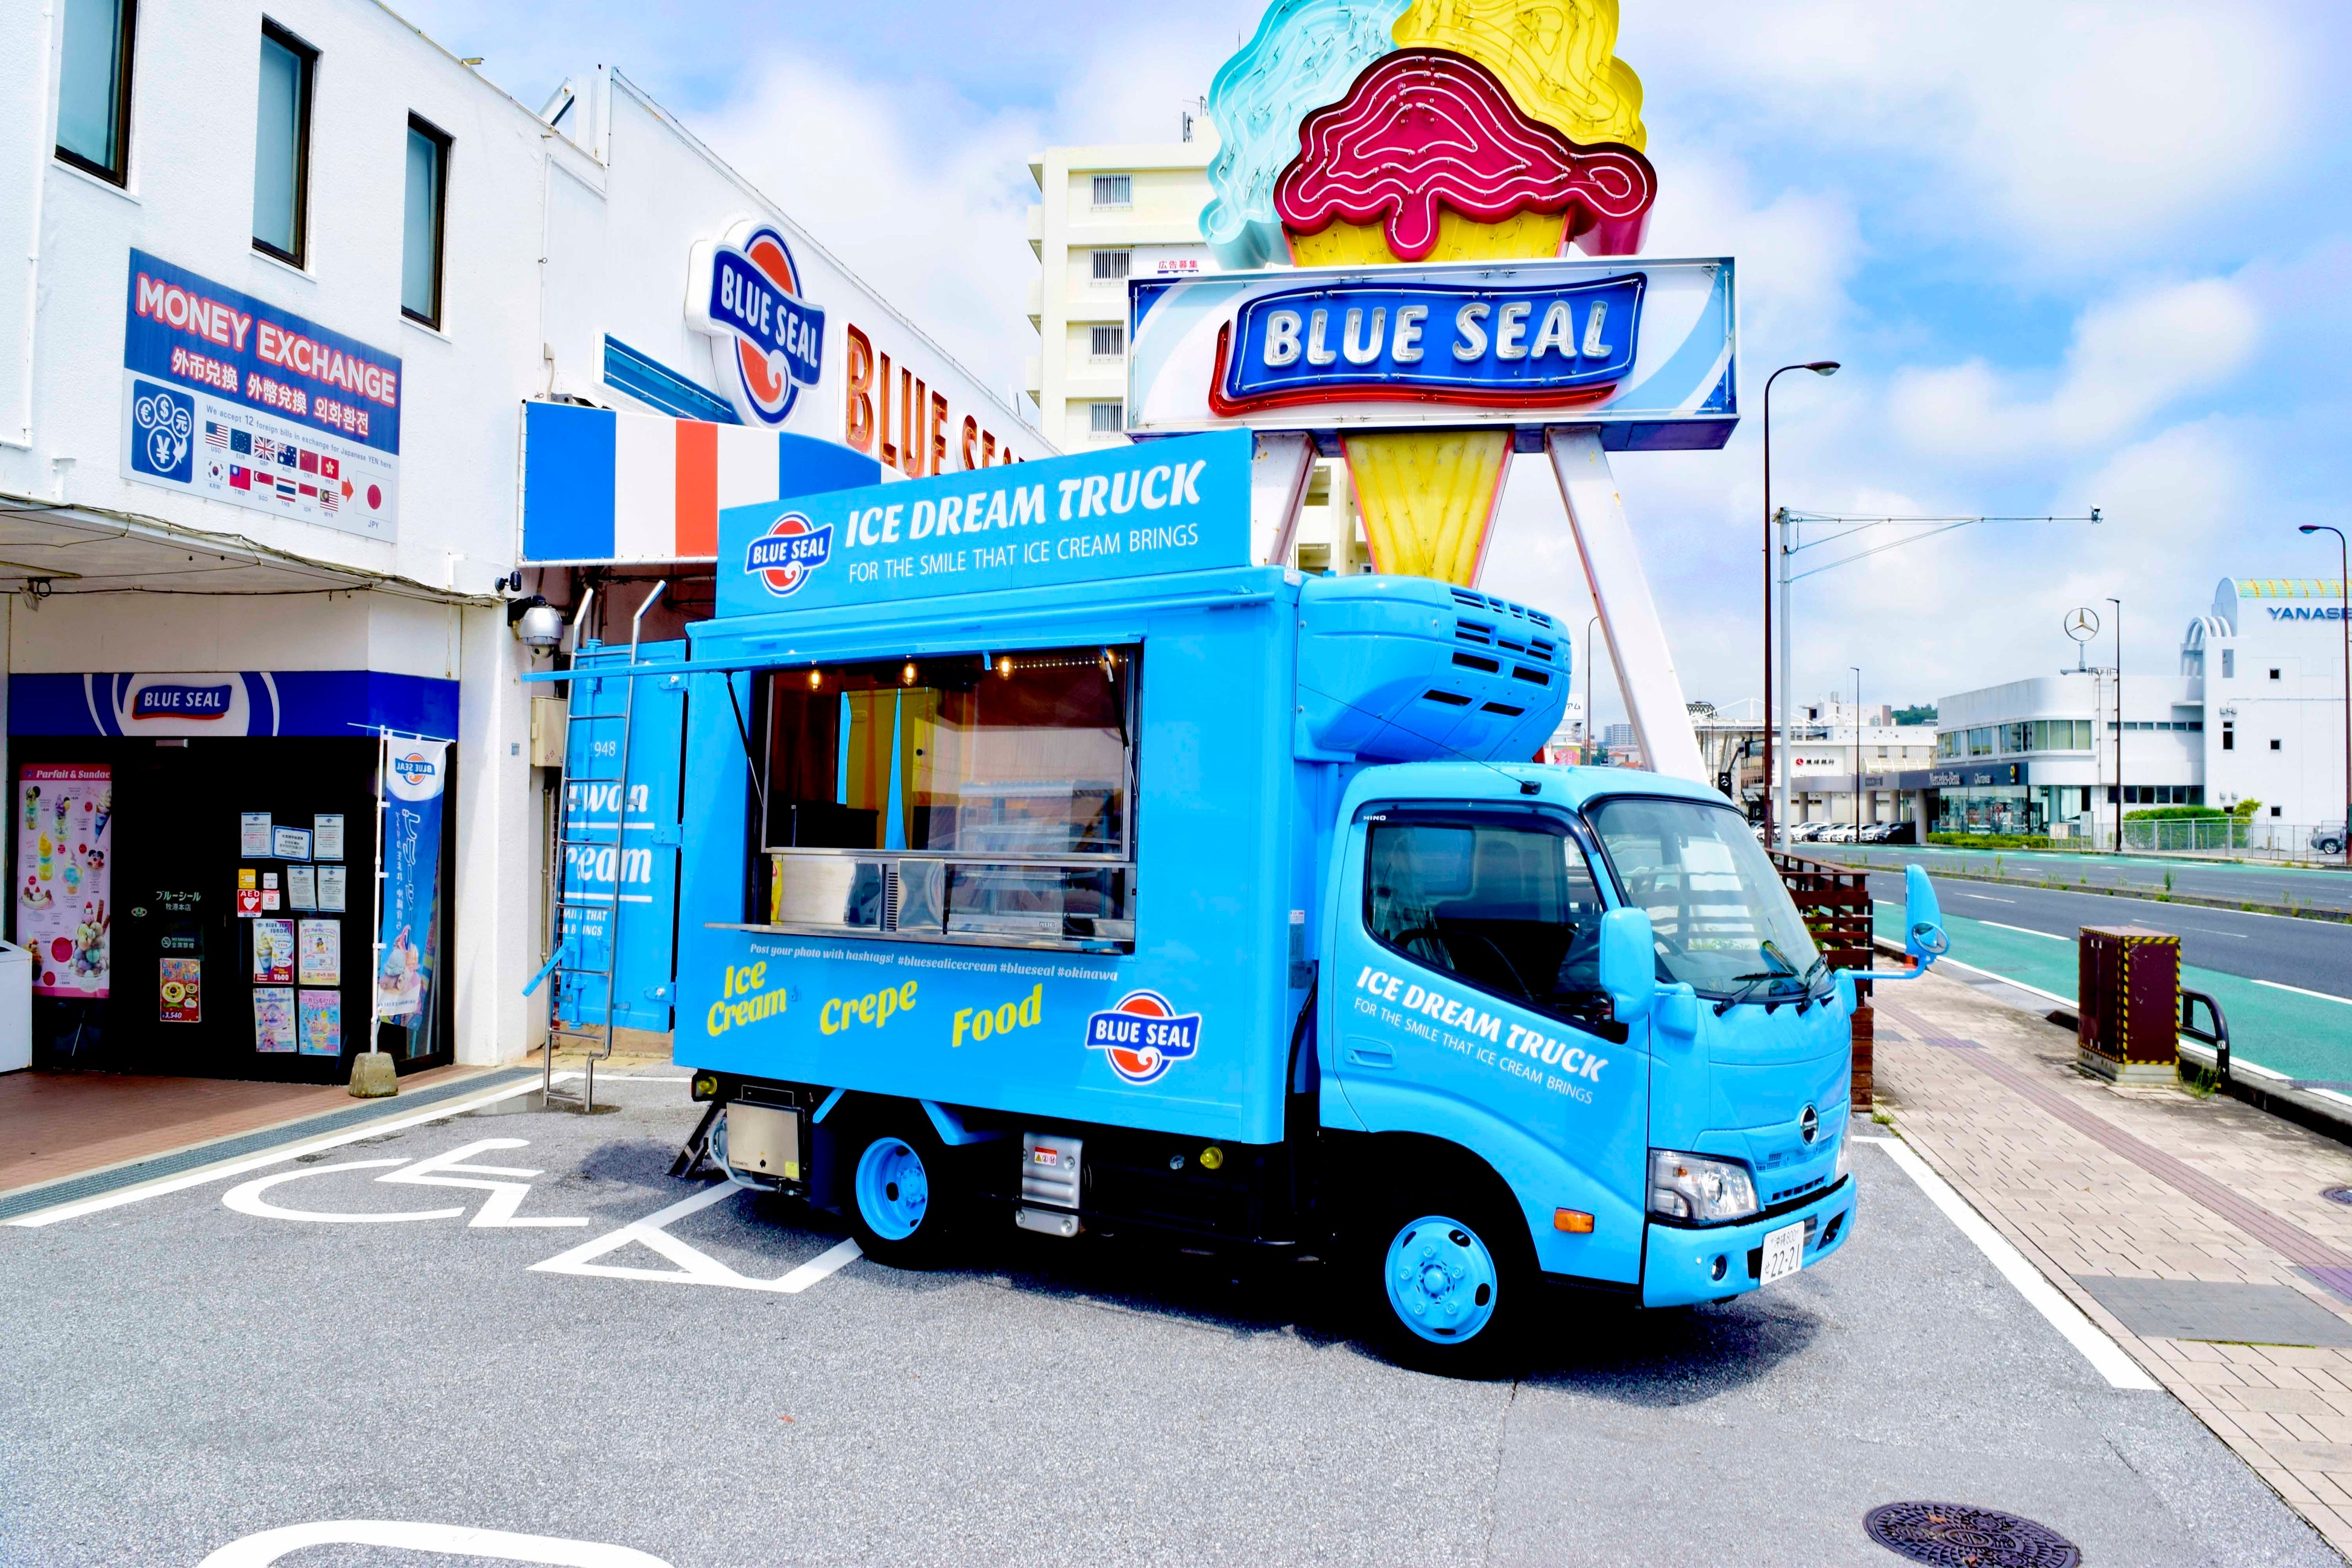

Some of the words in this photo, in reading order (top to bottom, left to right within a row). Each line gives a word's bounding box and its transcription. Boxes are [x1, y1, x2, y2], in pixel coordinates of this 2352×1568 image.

[1159, 260, 1198, 269] 広告募集
[138, 276, 250, 349] MONEY
[258, 324, 396, 405] EXCHANGE
[721, 264, 770, 336] BLUE
[774, 304, 818, 368] SEAL
[1263, 305, 1429, 368] BLUE
[1452, 301, 1613, 362] SEAL
[315, 399, 369, 436] 외화환전
[846, 323, 949, 480] BLUE
[206, 405, 217, 415] We
[220, 411, 241, 423] accept
[245, 416, 254, 426] 12
[256, 420, 278, 434] foreign
[280, 429, 292, 438] bills
[302, 436, 329, 449] exchange
[341, 448, 366, 461] Japanese
[368, 456, 379, 465] YEN
[381, 461, 393, 469] here.
[368, 520, 379, 529] JPY
[845, 506, 900, 548] ICE
[909, 484, 1046, 539] DREAM
[1058, 460, 1206, 518] TRUCK
[753, 543, 786, 563] BLUE
[791, 537, 826, 558] SEAL
[849, 561, 879, 583] FOR
[885, 558, 914, 578] THE
[920, 551, 966, 574] SMILE
[972, 546, 1017, 567] THAT
[1023, 542, 1050, 563] ICE
[1057, 535, 1121, 559] CREAM
[1129, 523, 1199, 551] BRINGS
[144, 692, 181, 707] BLUE
[186, 692, 221, 707] SEAL
[36, 770, 69, 779] Parfait
[70, 770, 77, 779] &
[78, 770, 110, 779] Sundae
[156, 891, 201, 902] ブルーシール
[571, 924, 602, 936] BINGS
[724, 960, 767, 999] Ice
[750, 943, 769, 954] Post
[771, 947, 792, 957] your
[794, 946, 820, 958] photo
[823, 949, 844, 959] with
[846, 949, 894, 965] hashtags!
[897, 955, 997, 973] #bluesealicecream
[1000, 962, 1055, 977] #blueseal
[1057, 966, 1118, 982] #okinawa
[707, 985, 787, 1037] Cream
[820, 980, 917, 1036] Crepe
[952, 983, 1042, 1048] Food
[1095, 1020, 1141, 1045] BLUE
[1146, 1025, 1191, 1048] SEAL
[1356, 966, 1405, 1002] ICE
[1402, 979, 1502, 1043] DREAM
[1507, 1024, 1609, 1083] TRUCK
[1355, 997, 1377, 1017] FOR
[1381, 1008, 1401, 1027] THE
[1405, 1018, 1439, 1041] SMILE
[1443, 1032, 1473, 1055] THAT
[1476, 1046, 1495, 1066] ICE
[1500, 1057, 1542, 1085] CREAM
[1547, 1076, 1593, 1104] BRINGS
